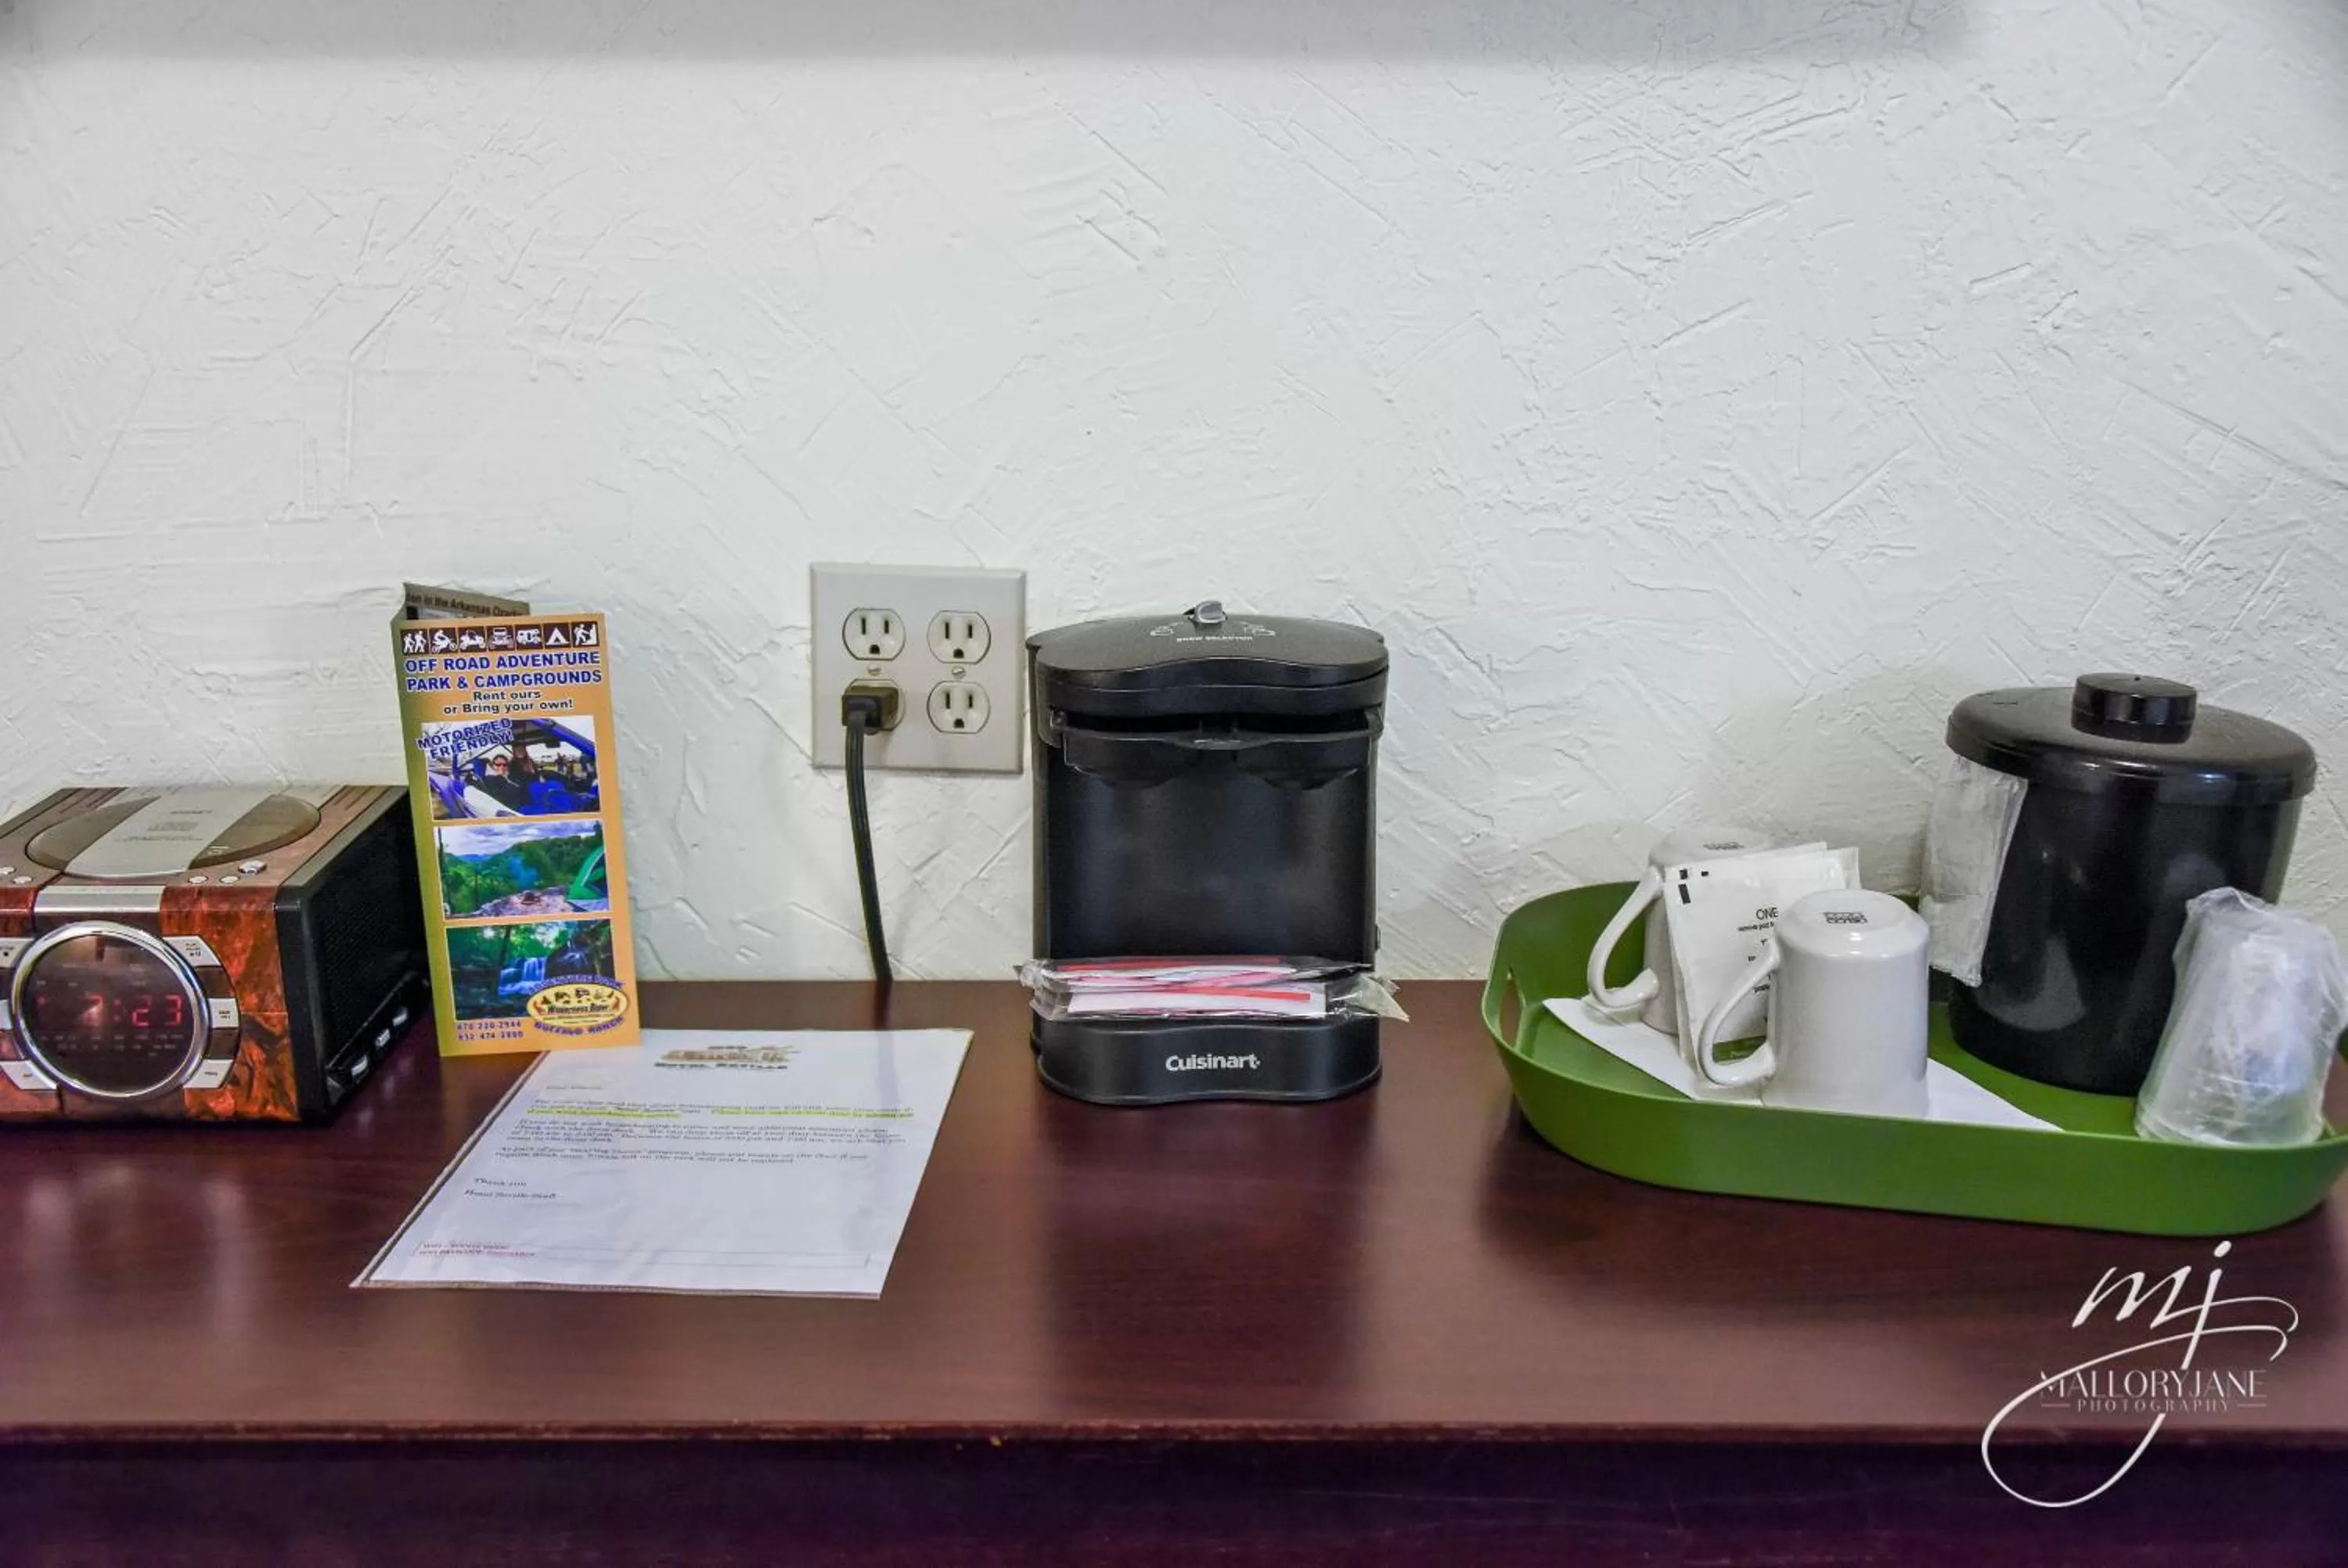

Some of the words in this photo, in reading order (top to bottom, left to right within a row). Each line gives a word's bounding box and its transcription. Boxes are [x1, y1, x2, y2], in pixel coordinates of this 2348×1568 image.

[450, 599, 492, 614] Arkansas
[405, 658, 437, 673] OFF
[444, 656, 490, 671] ROAD
[496, 651, 600, 669] ADVENTURE
[406, 677, 451, 691] PARK
[456, 676, 467, 689] &
[474, 669, 602, 689] CAMPGROUNDS
[473, 690, 506, 702] Rent
[510, 690, 542, 699] ours
[444, 706, 457, 715] or
[463, 703, 500, 715] Bring
[505, 702, 534, 714] your
[539, 699, 573, 710] own!
[416, 717, 511, 750] MOTORIZED
[1165, 1052, 1258, 1071] Cuisinart
